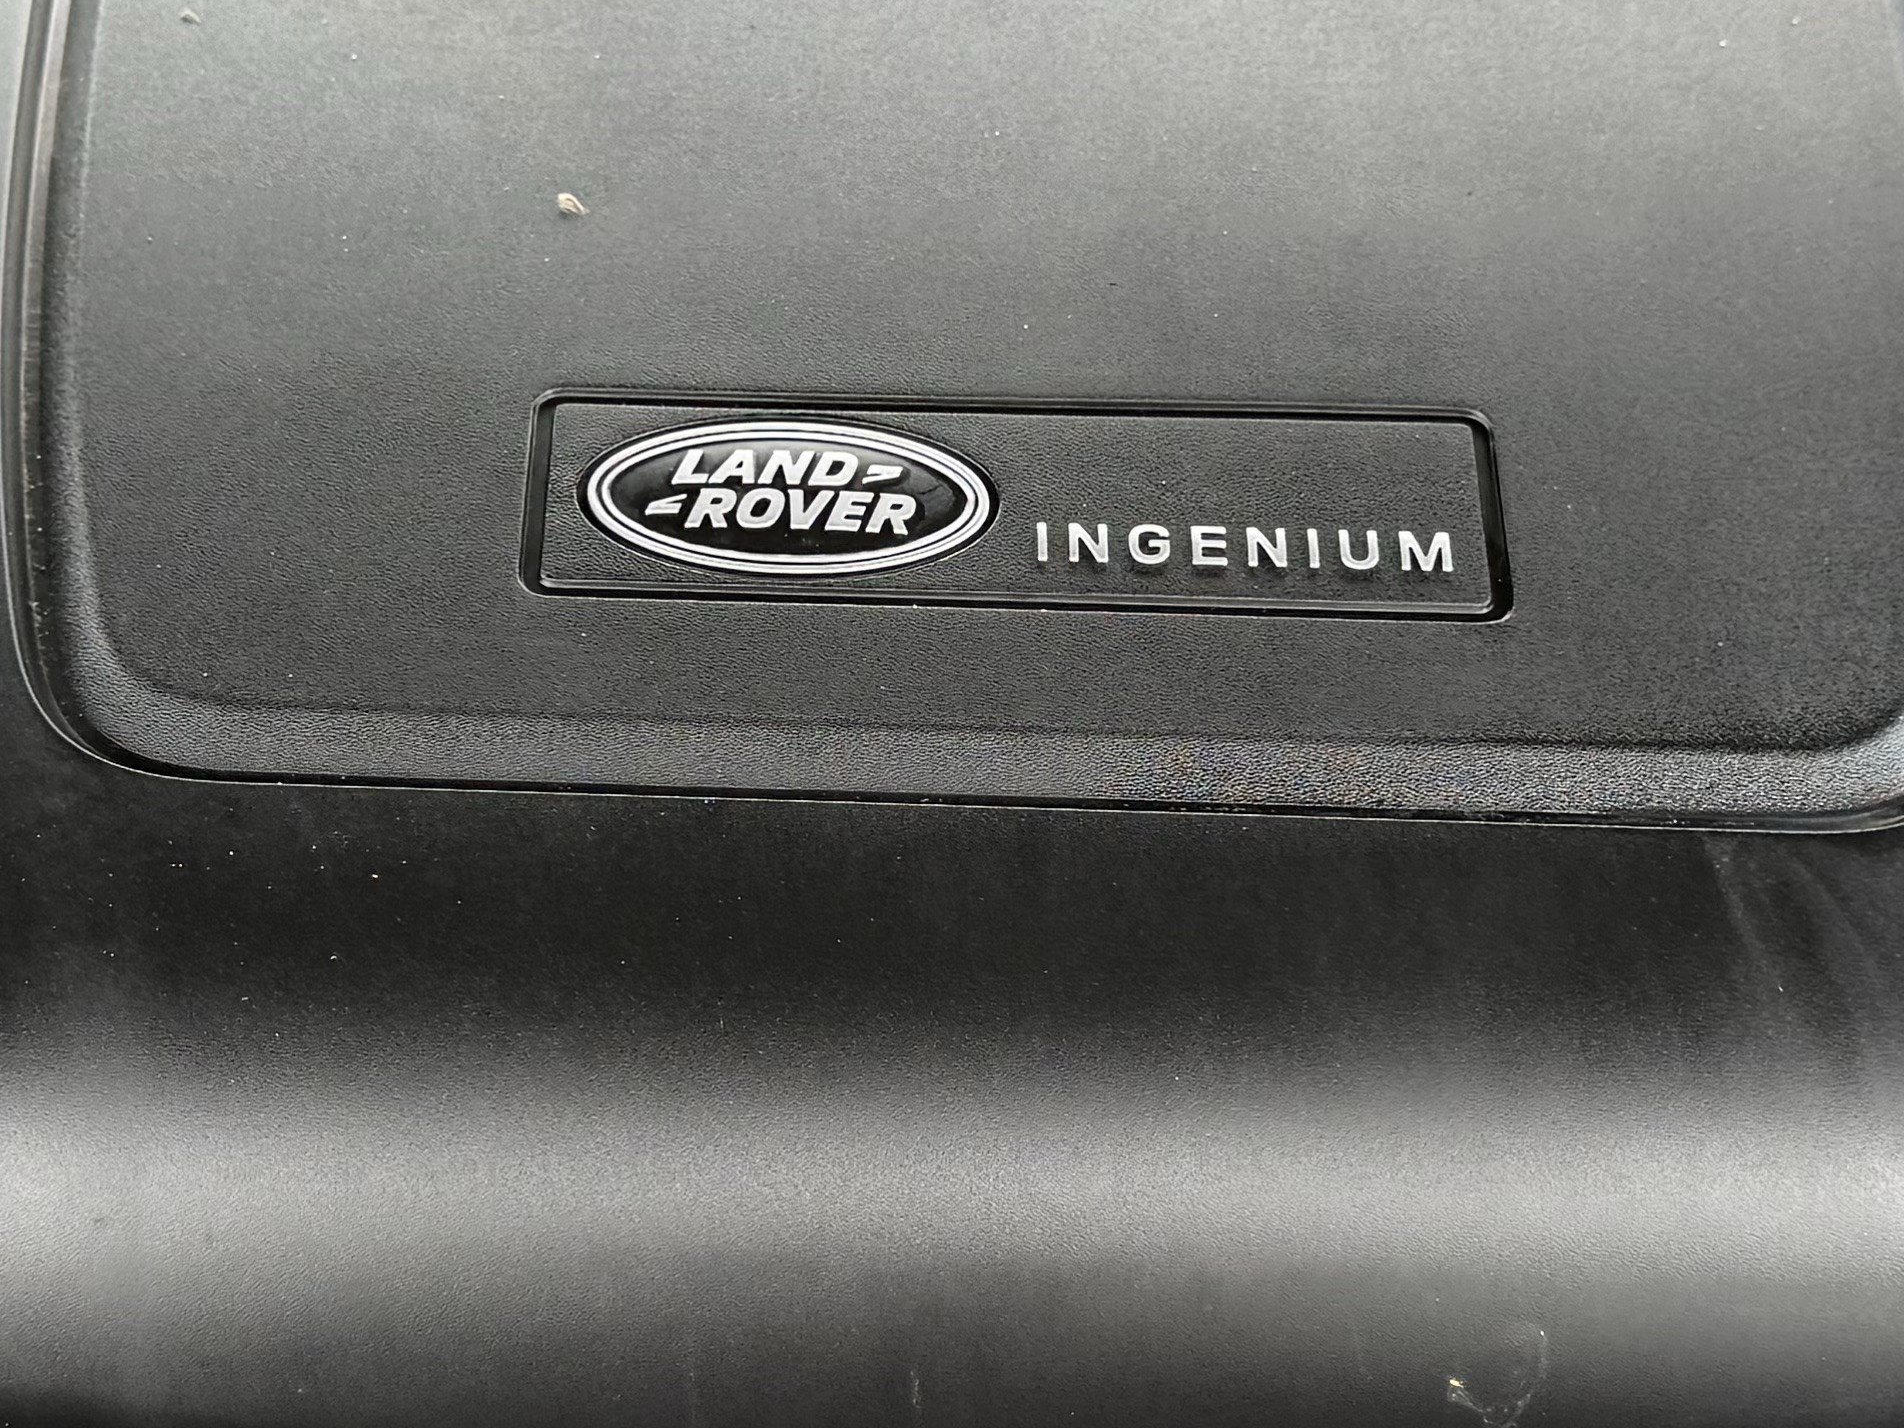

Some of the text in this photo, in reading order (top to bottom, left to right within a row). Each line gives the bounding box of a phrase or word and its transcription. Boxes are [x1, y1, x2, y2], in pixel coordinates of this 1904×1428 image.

[671, 448, 859, 487] LAND
[683, 488, 918, 535] ROVER
[1035, 520, 1454, 573] INGENIUM
